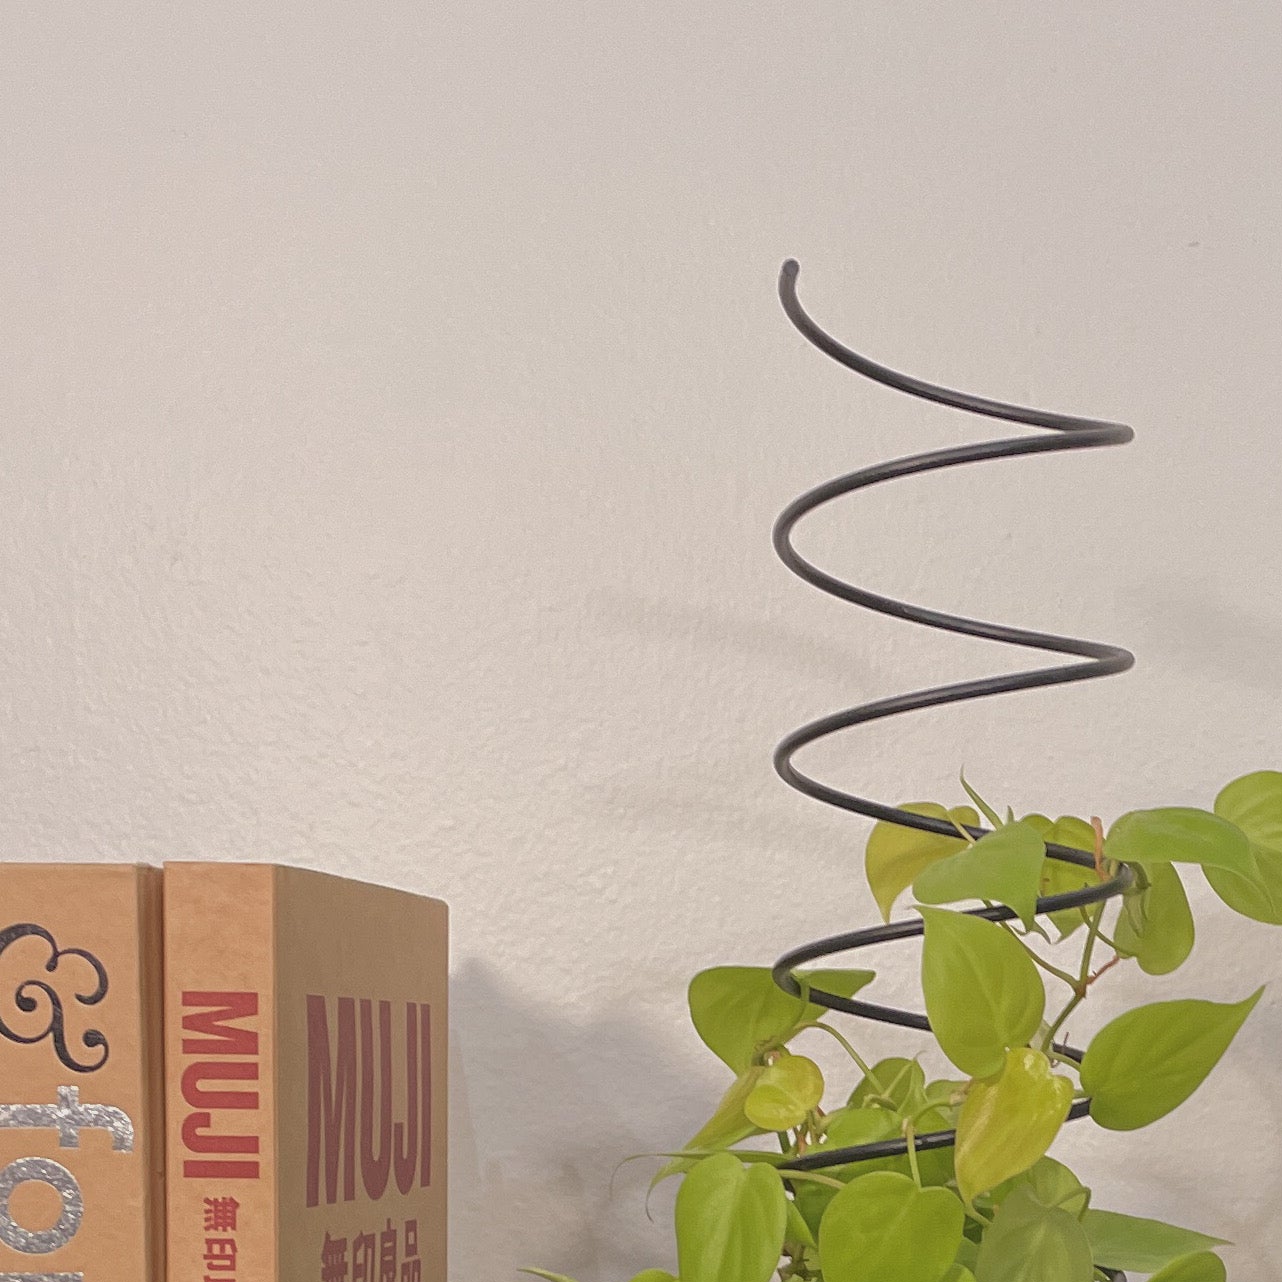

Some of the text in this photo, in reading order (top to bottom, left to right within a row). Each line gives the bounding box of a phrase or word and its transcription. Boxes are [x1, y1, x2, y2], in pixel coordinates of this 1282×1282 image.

[0, 923, 109, 1073] &
[180, 991, 261, 1179] MUJI
[306, 994, 431, 1208] MUJI
